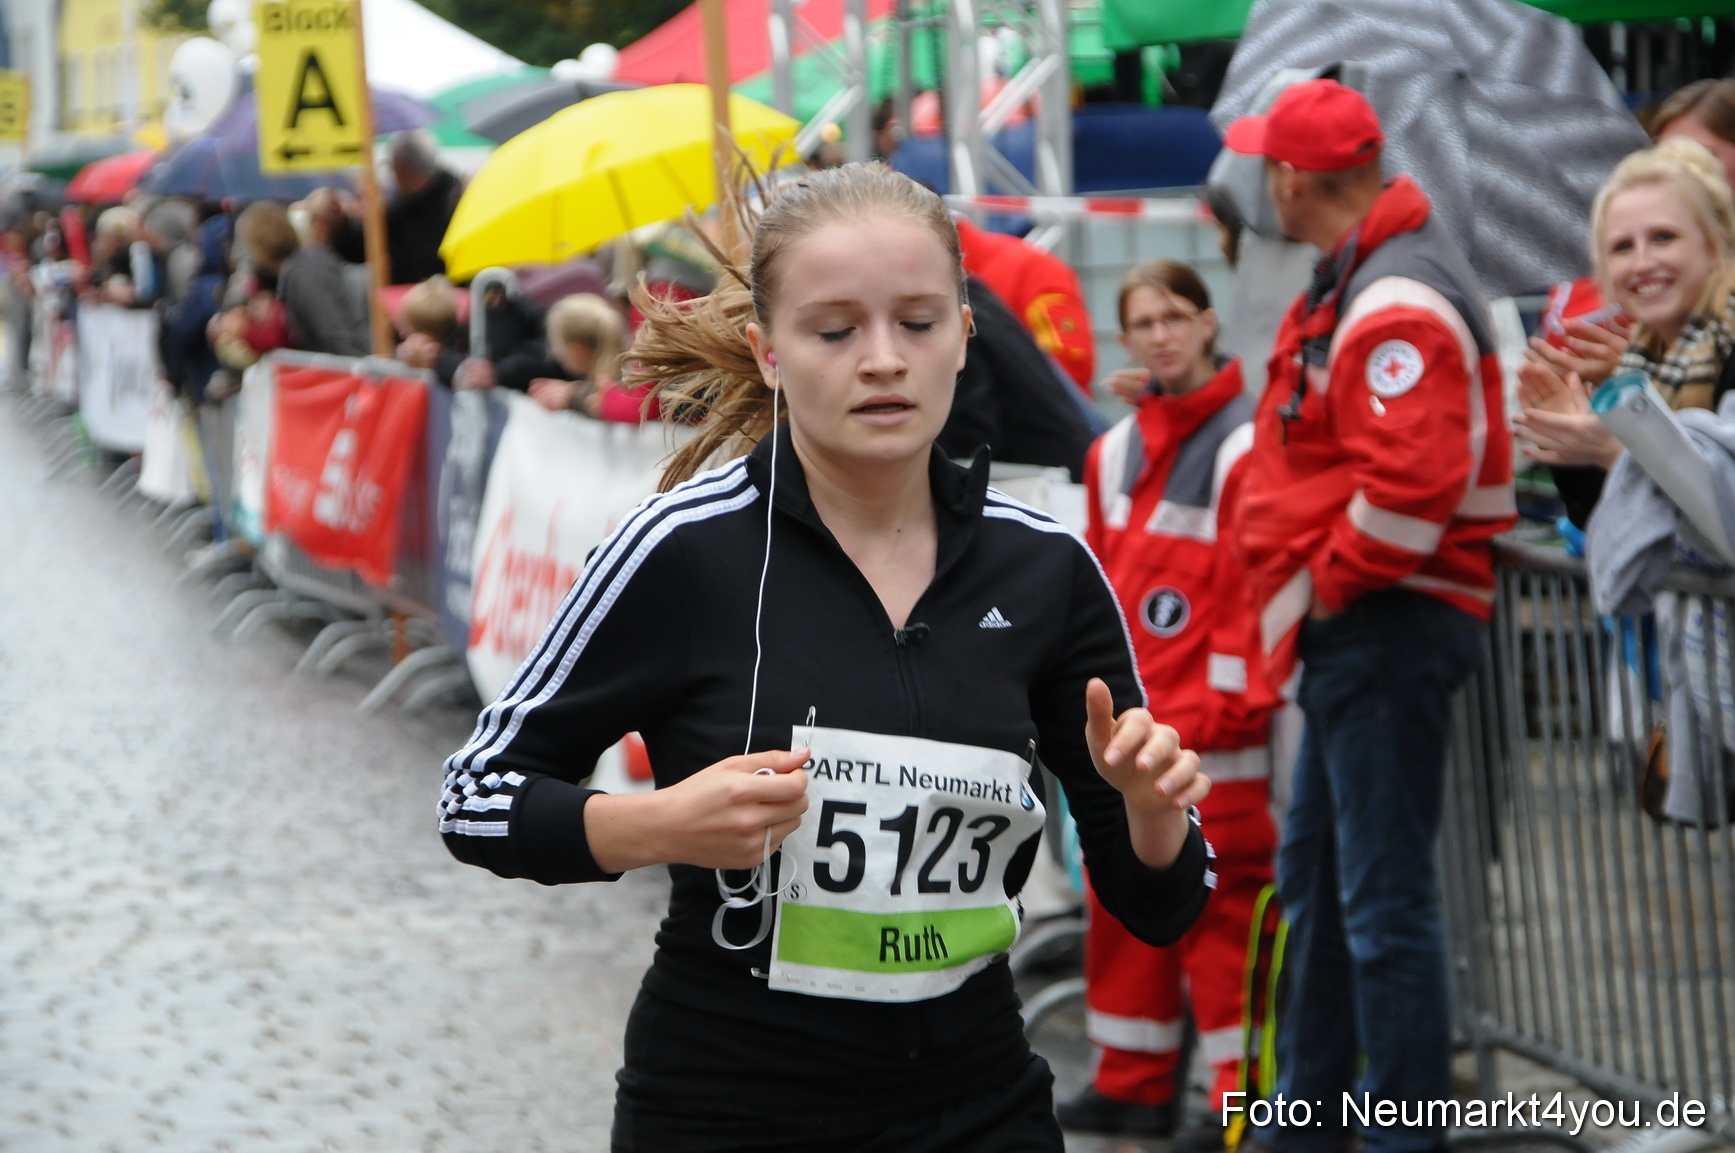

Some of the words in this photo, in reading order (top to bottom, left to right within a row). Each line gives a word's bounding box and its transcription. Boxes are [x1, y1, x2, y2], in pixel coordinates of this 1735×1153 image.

[262, 3, 357, 33] Block
[284, 46, 347, 129] A
[899, 764, 1012, 804] Neumarkt
[812, 799, 1012, 897] 5123
[879, 924, 949, 963] Ruth
